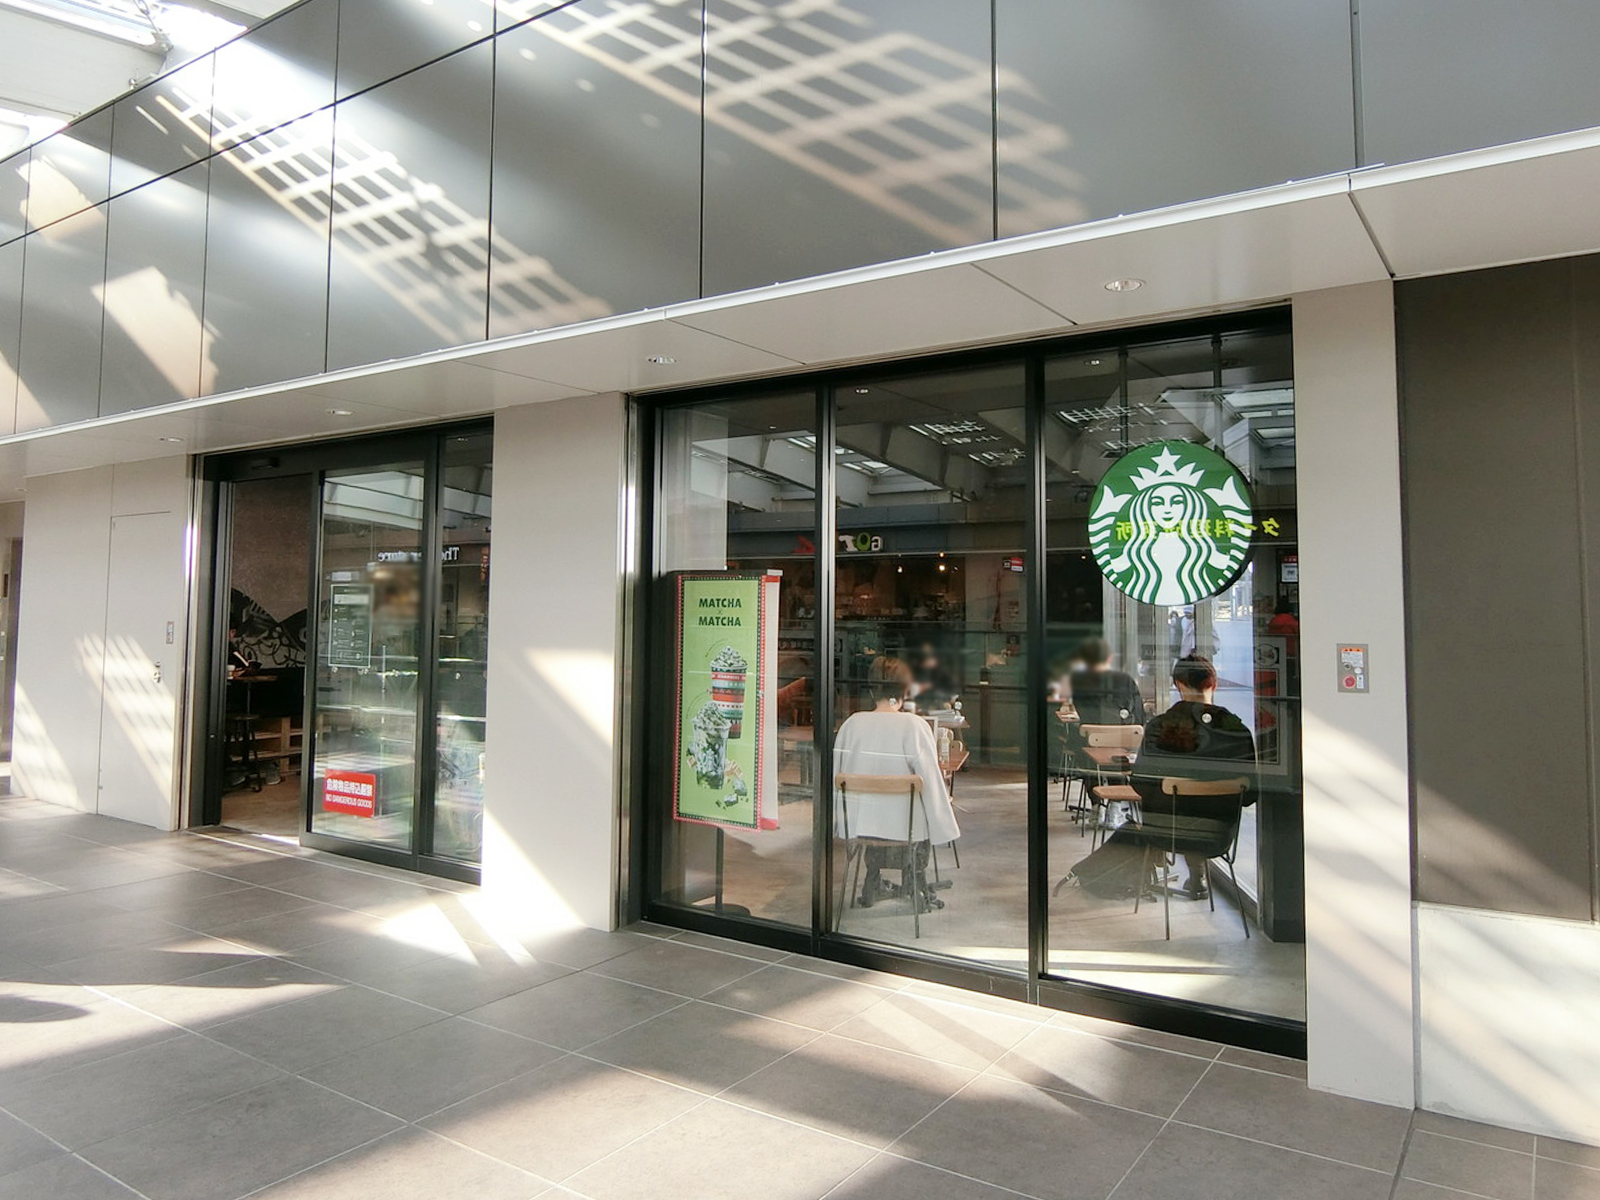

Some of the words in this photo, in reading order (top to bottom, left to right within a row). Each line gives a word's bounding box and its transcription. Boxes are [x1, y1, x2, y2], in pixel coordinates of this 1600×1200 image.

[698, 598, 742, 608] MATCHA
[698, 616, 741, 627] MATCHA
[325, 793, 333, 802] NO
